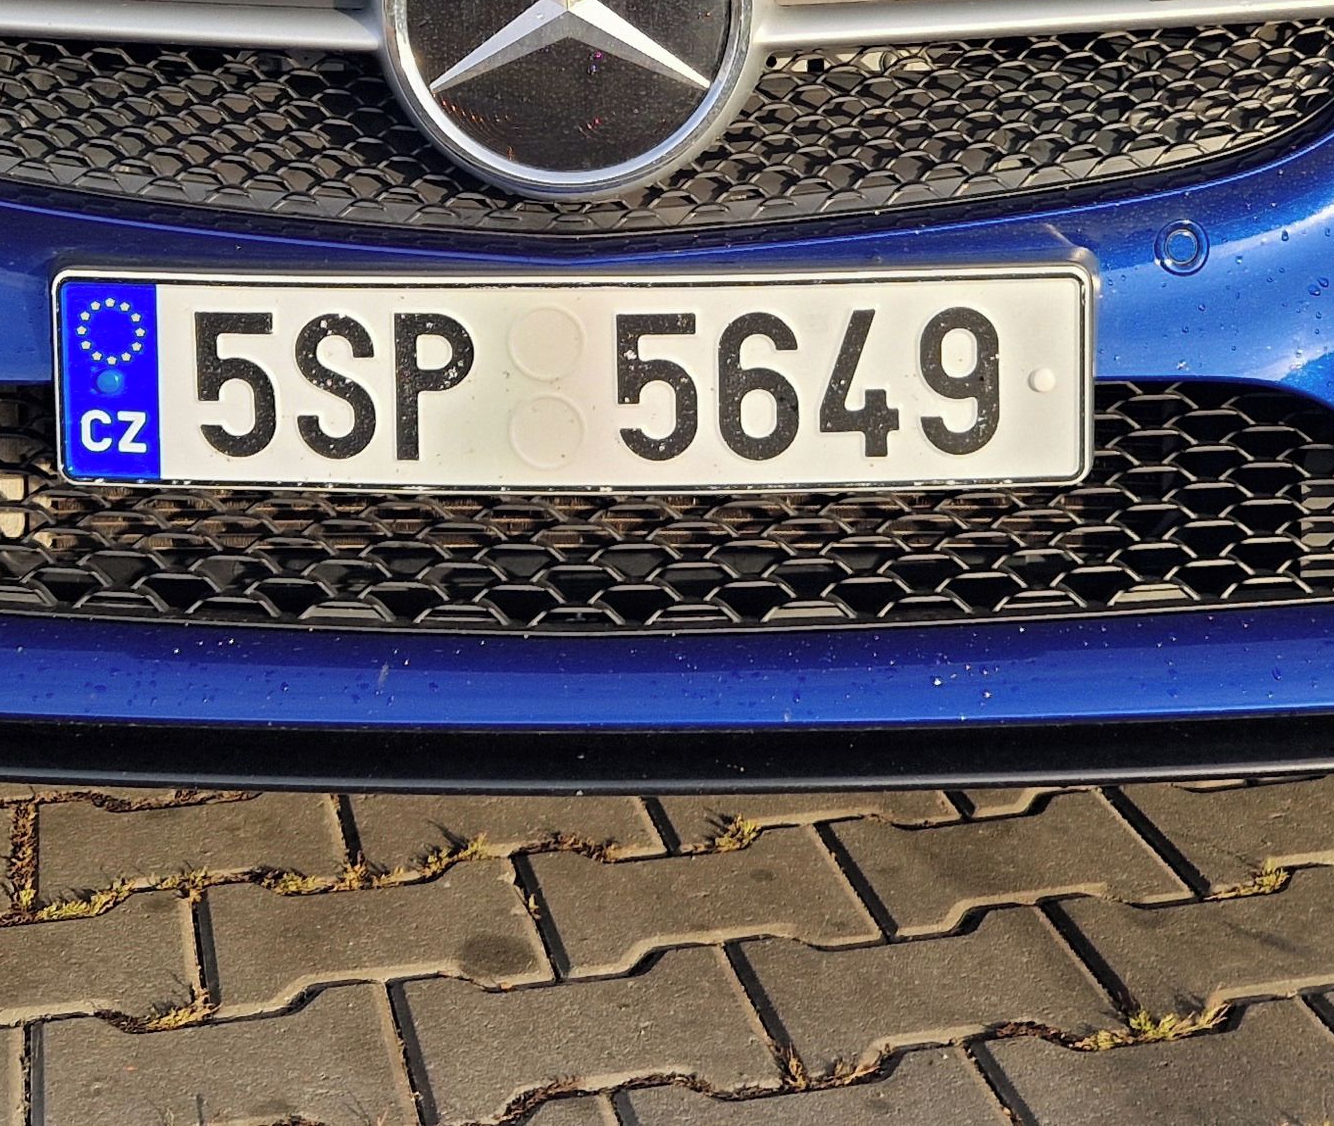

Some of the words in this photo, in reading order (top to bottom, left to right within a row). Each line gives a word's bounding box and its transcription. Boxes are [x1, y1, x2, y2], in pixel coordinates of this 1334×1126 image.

[79, 408, 148, 453] CZ
[192, 310, 475, 462] 5SP
[614, 305, 1002, 462] 5649
